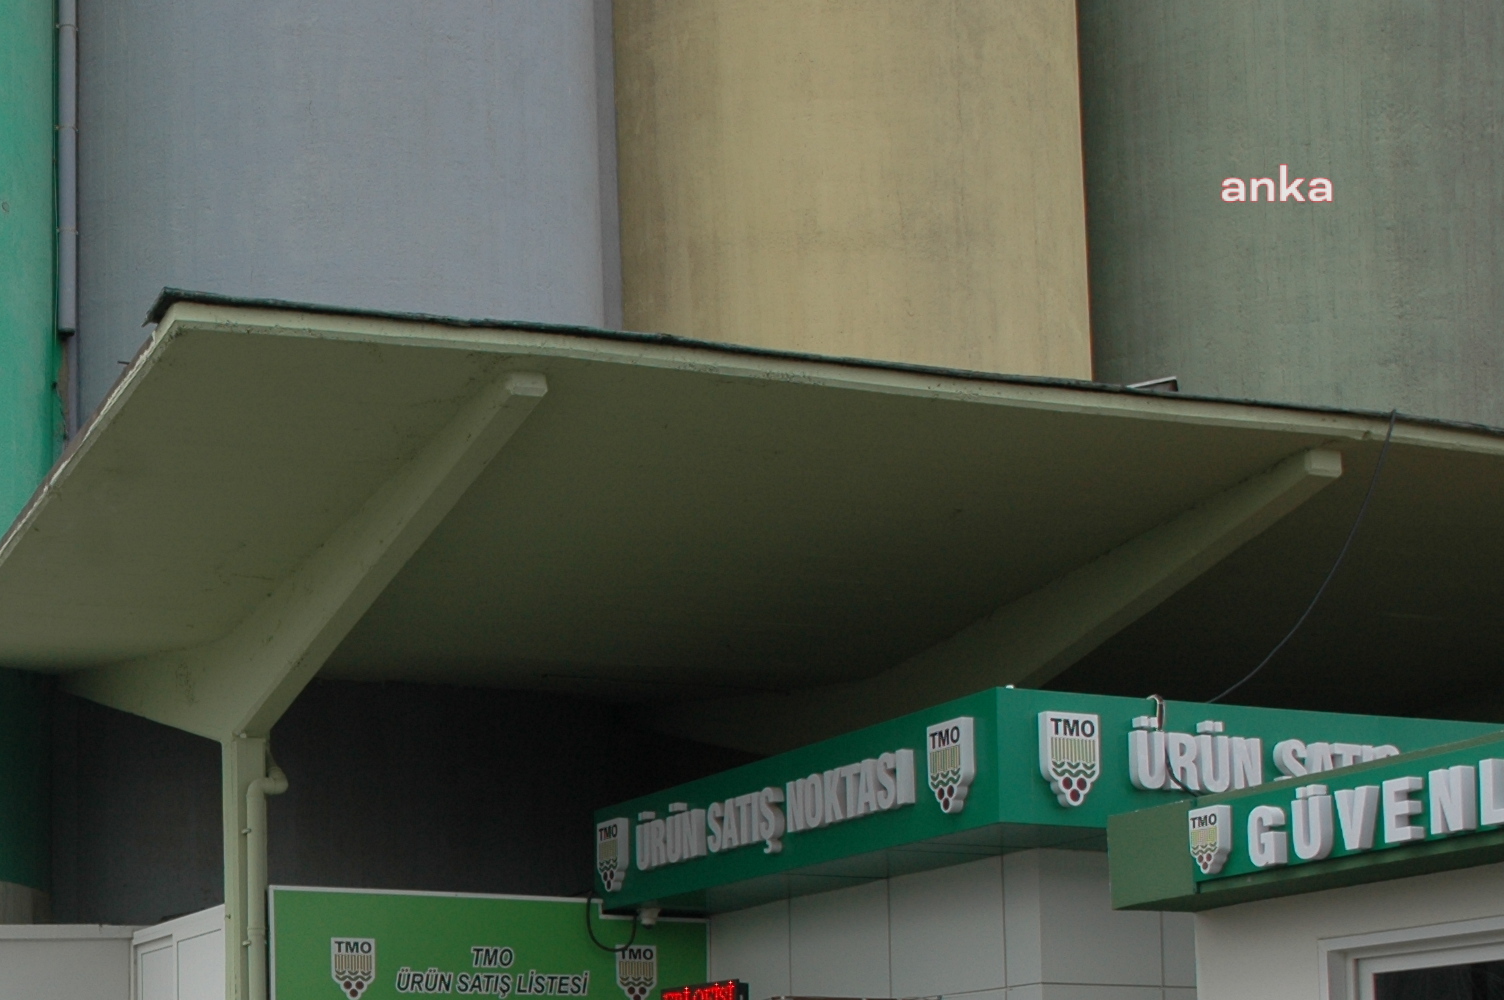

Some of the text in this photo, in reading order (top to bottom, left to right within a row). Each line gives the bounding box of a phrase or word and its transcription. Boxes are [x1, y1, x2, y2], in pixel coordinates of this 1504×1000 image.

[1049, 717, 1096, 738] TMO
[929, 726, 960, 750] TMO
[1128, 715, 1263, 794] ÜRÜN
[635, 748, 916, 871] ÜRÜN SATIŞ NOKTASI
[1189, 813, 1217, 829] TMO
[598, 823, 619, 840] TMO
[334, 941, 372, 954] TMO
[471, 947, 514, 967] TMO
[618, 948, 654, 961] TMO
[396, 967, 590, 999] ÜRÜN SATIŞ LİSTESİ
